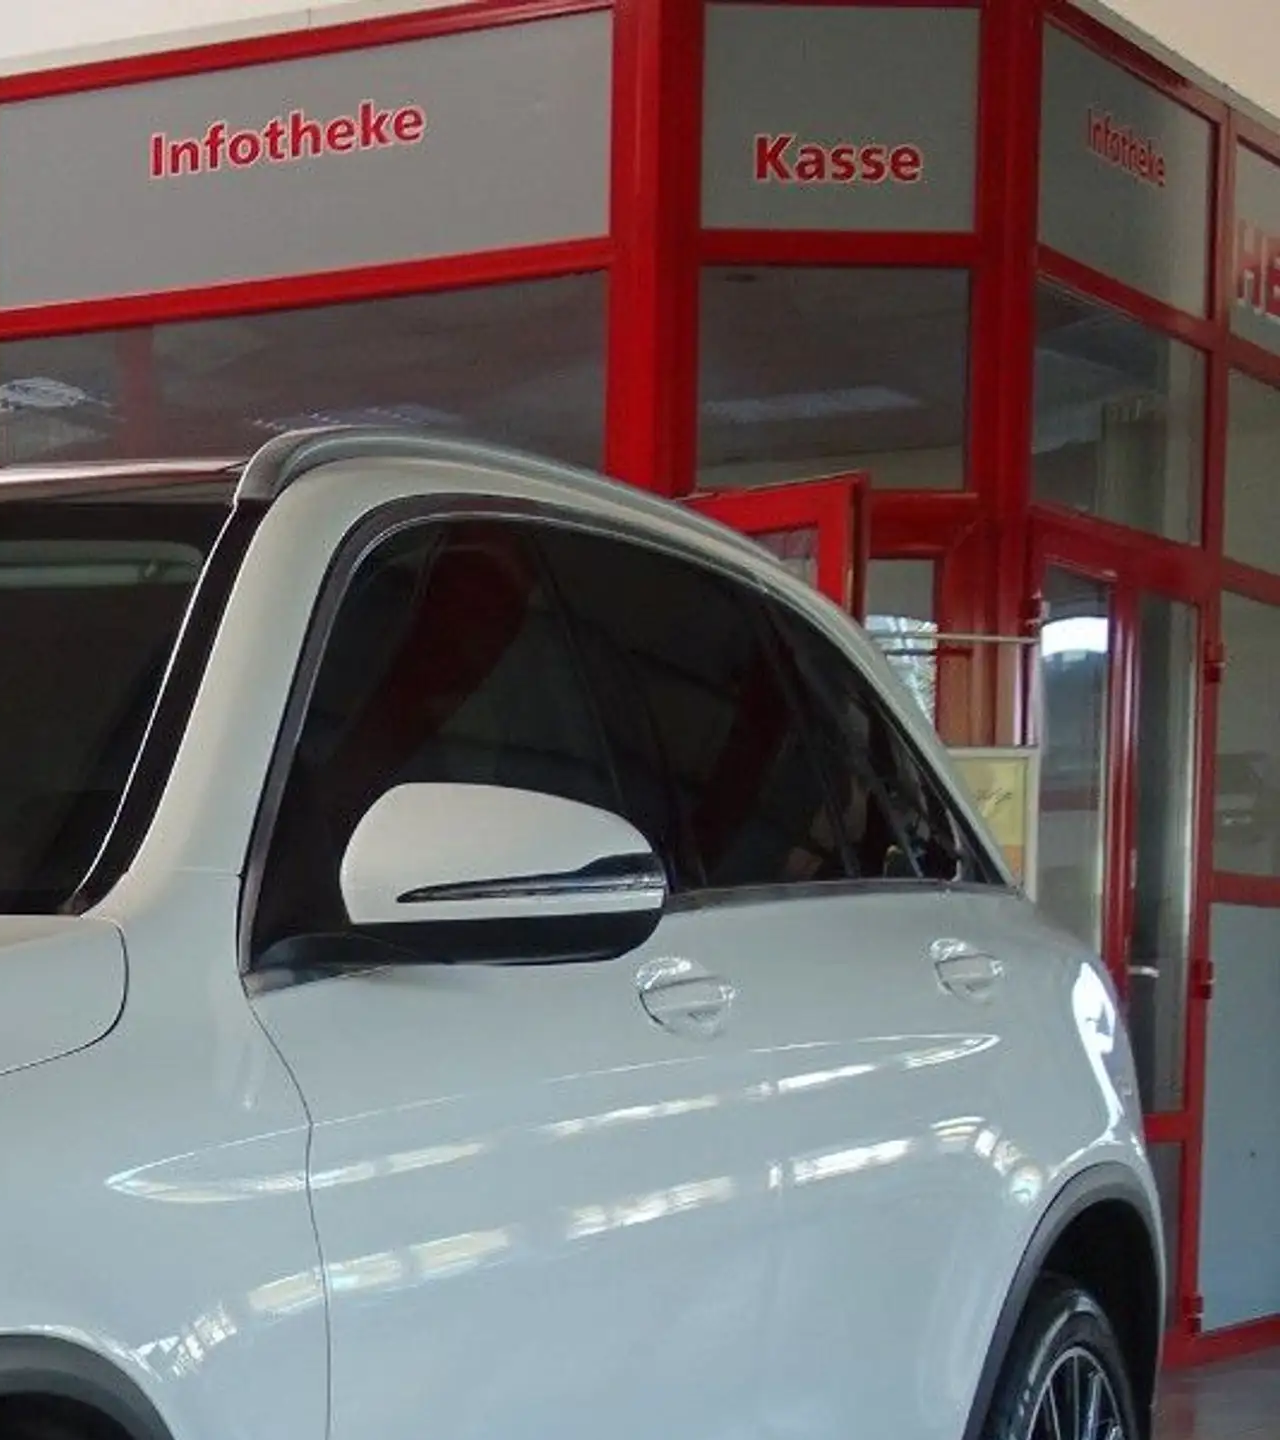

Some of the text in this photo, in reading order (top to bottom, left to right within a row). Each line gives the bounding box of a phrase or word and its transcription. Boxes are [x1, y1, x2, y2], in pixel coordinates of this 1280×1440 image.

[149, 101, 426, 178] Infotheke
[754, 133, 923, 183] Kasse
[1087, 108, 1166, 188] Infotheke
